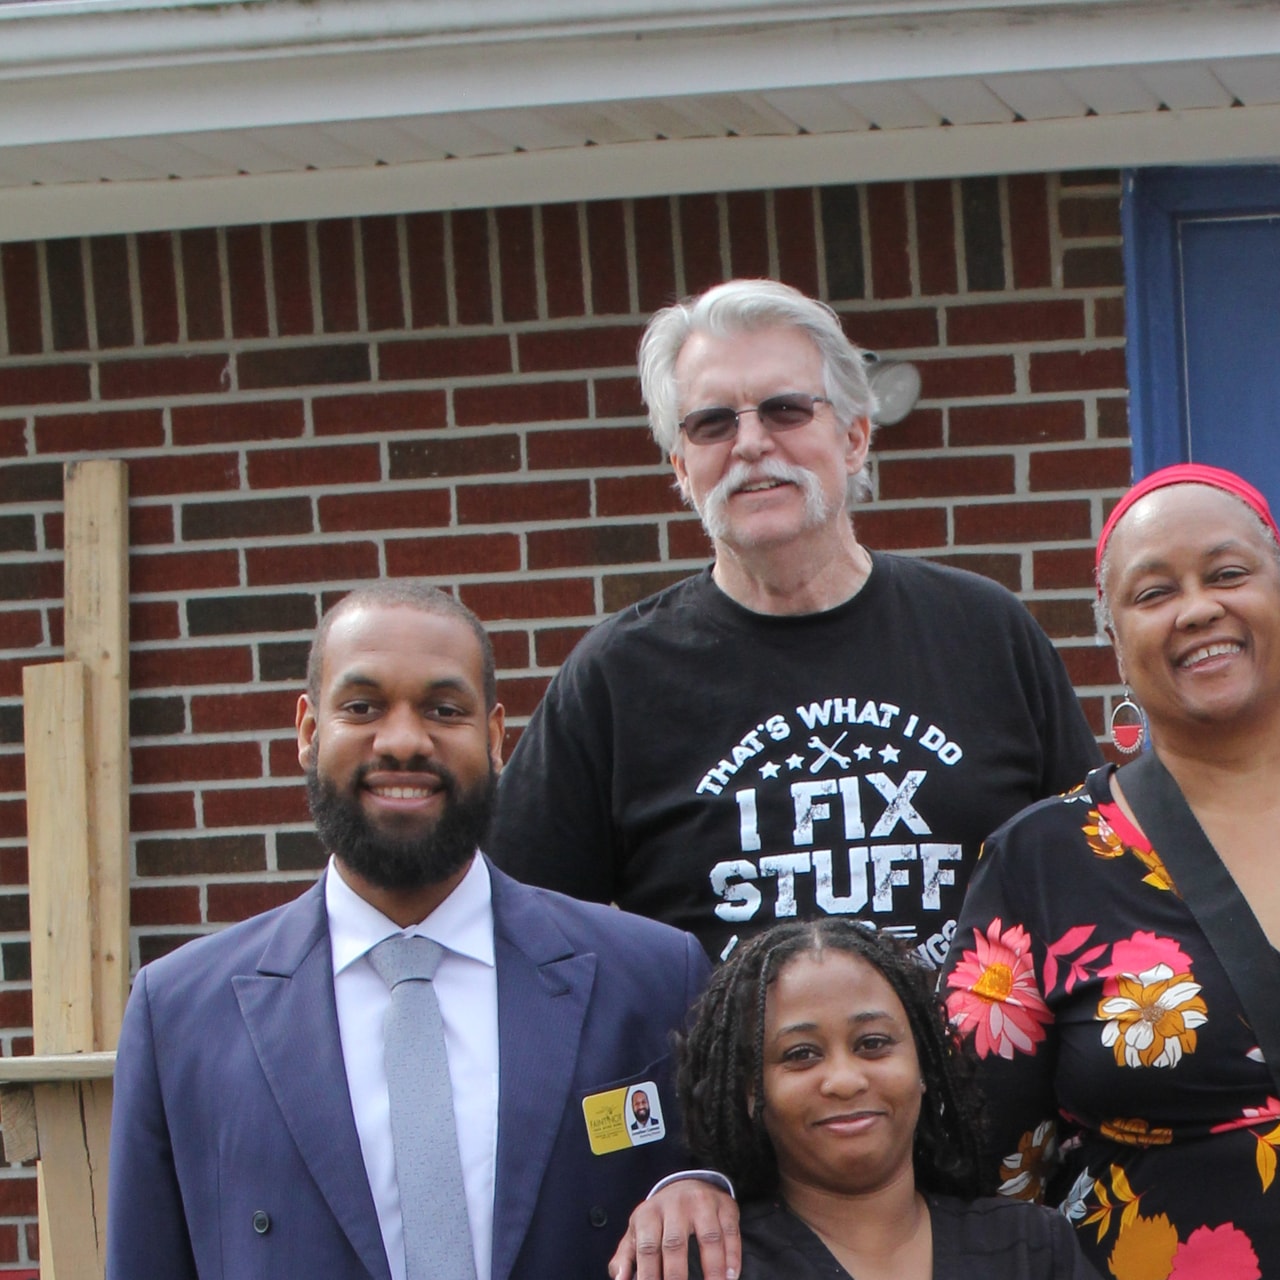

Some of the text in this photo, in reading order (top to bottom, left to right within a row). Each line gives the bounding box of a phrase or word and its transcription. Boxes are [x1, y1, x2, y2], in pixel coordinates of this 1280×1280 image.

[695, 698, 963, 796] THAT'S WHAT I DO
[736, 770, 933, 851] I FIX
[709, 843, 963, 922] STUFF
